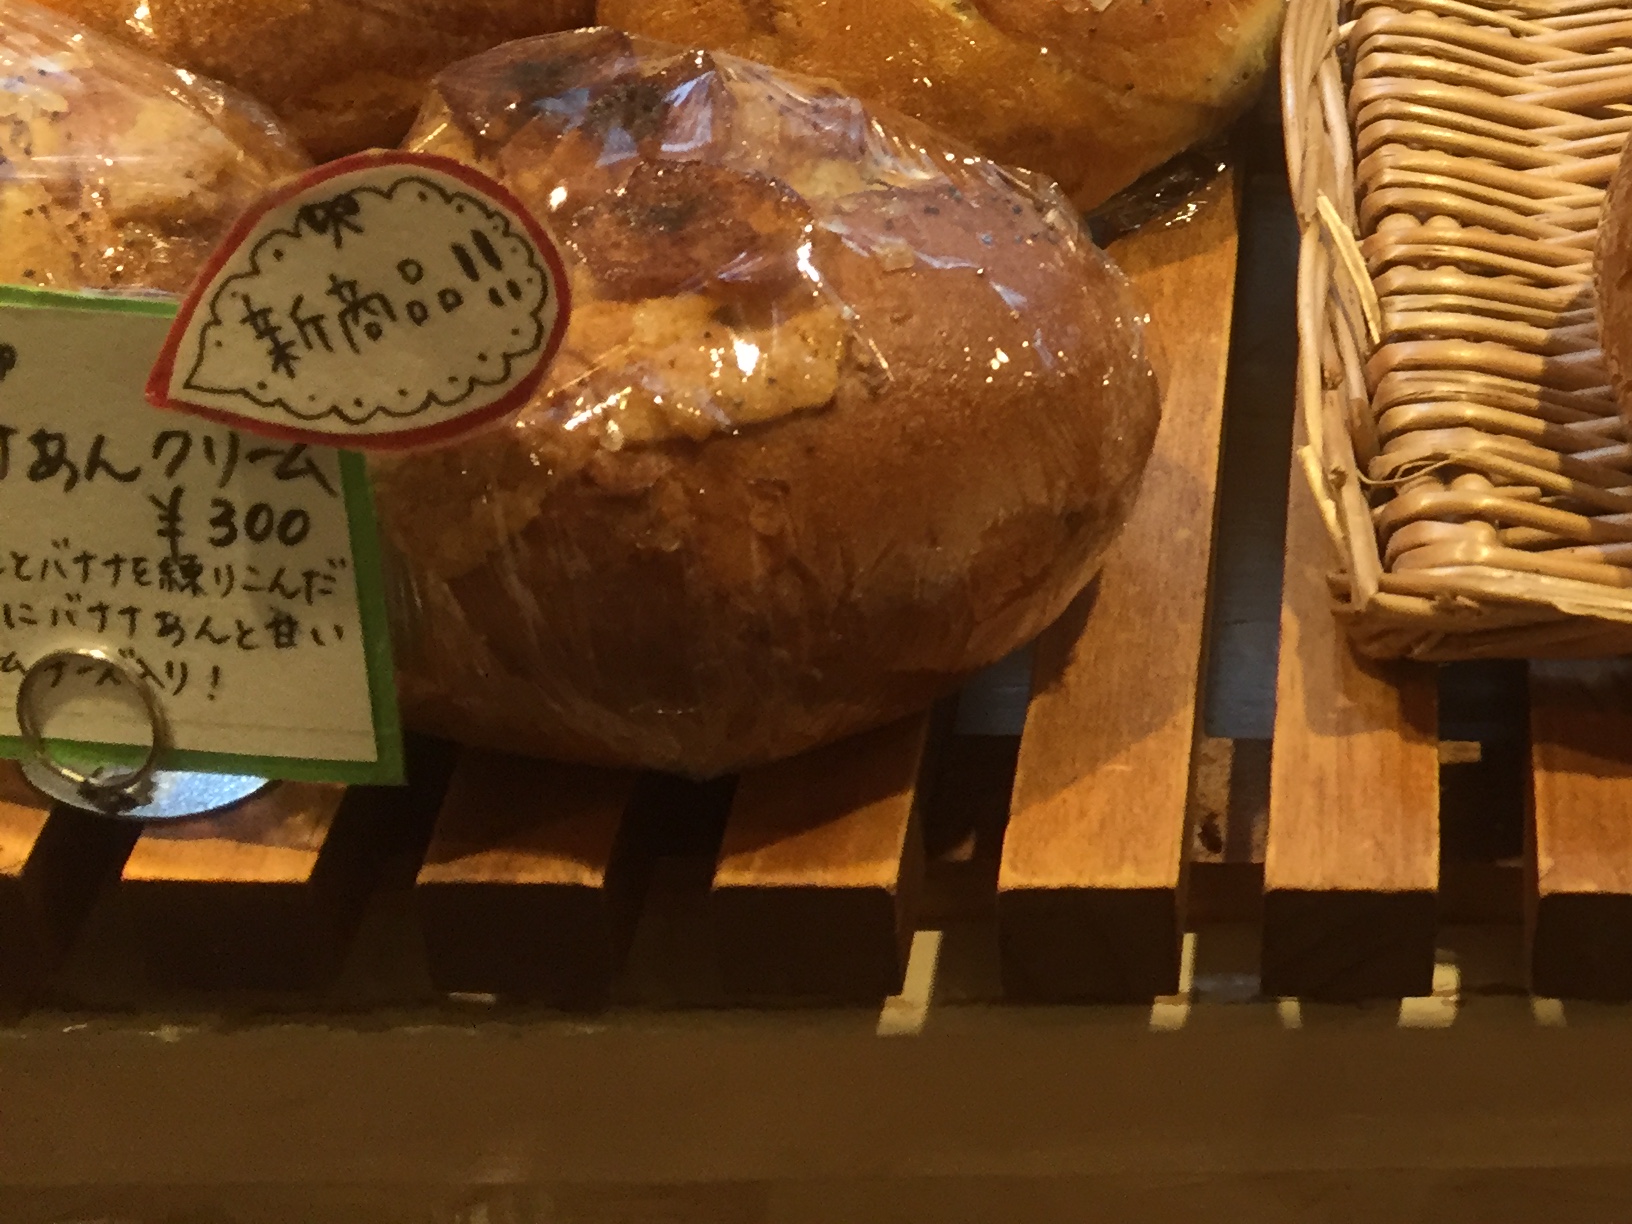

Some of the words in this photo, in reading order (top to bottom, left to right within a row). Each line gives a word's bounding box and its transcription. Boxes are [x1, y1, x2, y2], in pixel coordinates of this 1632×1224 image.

[0, 537, 347, 606] とバナナを練りこんだ
